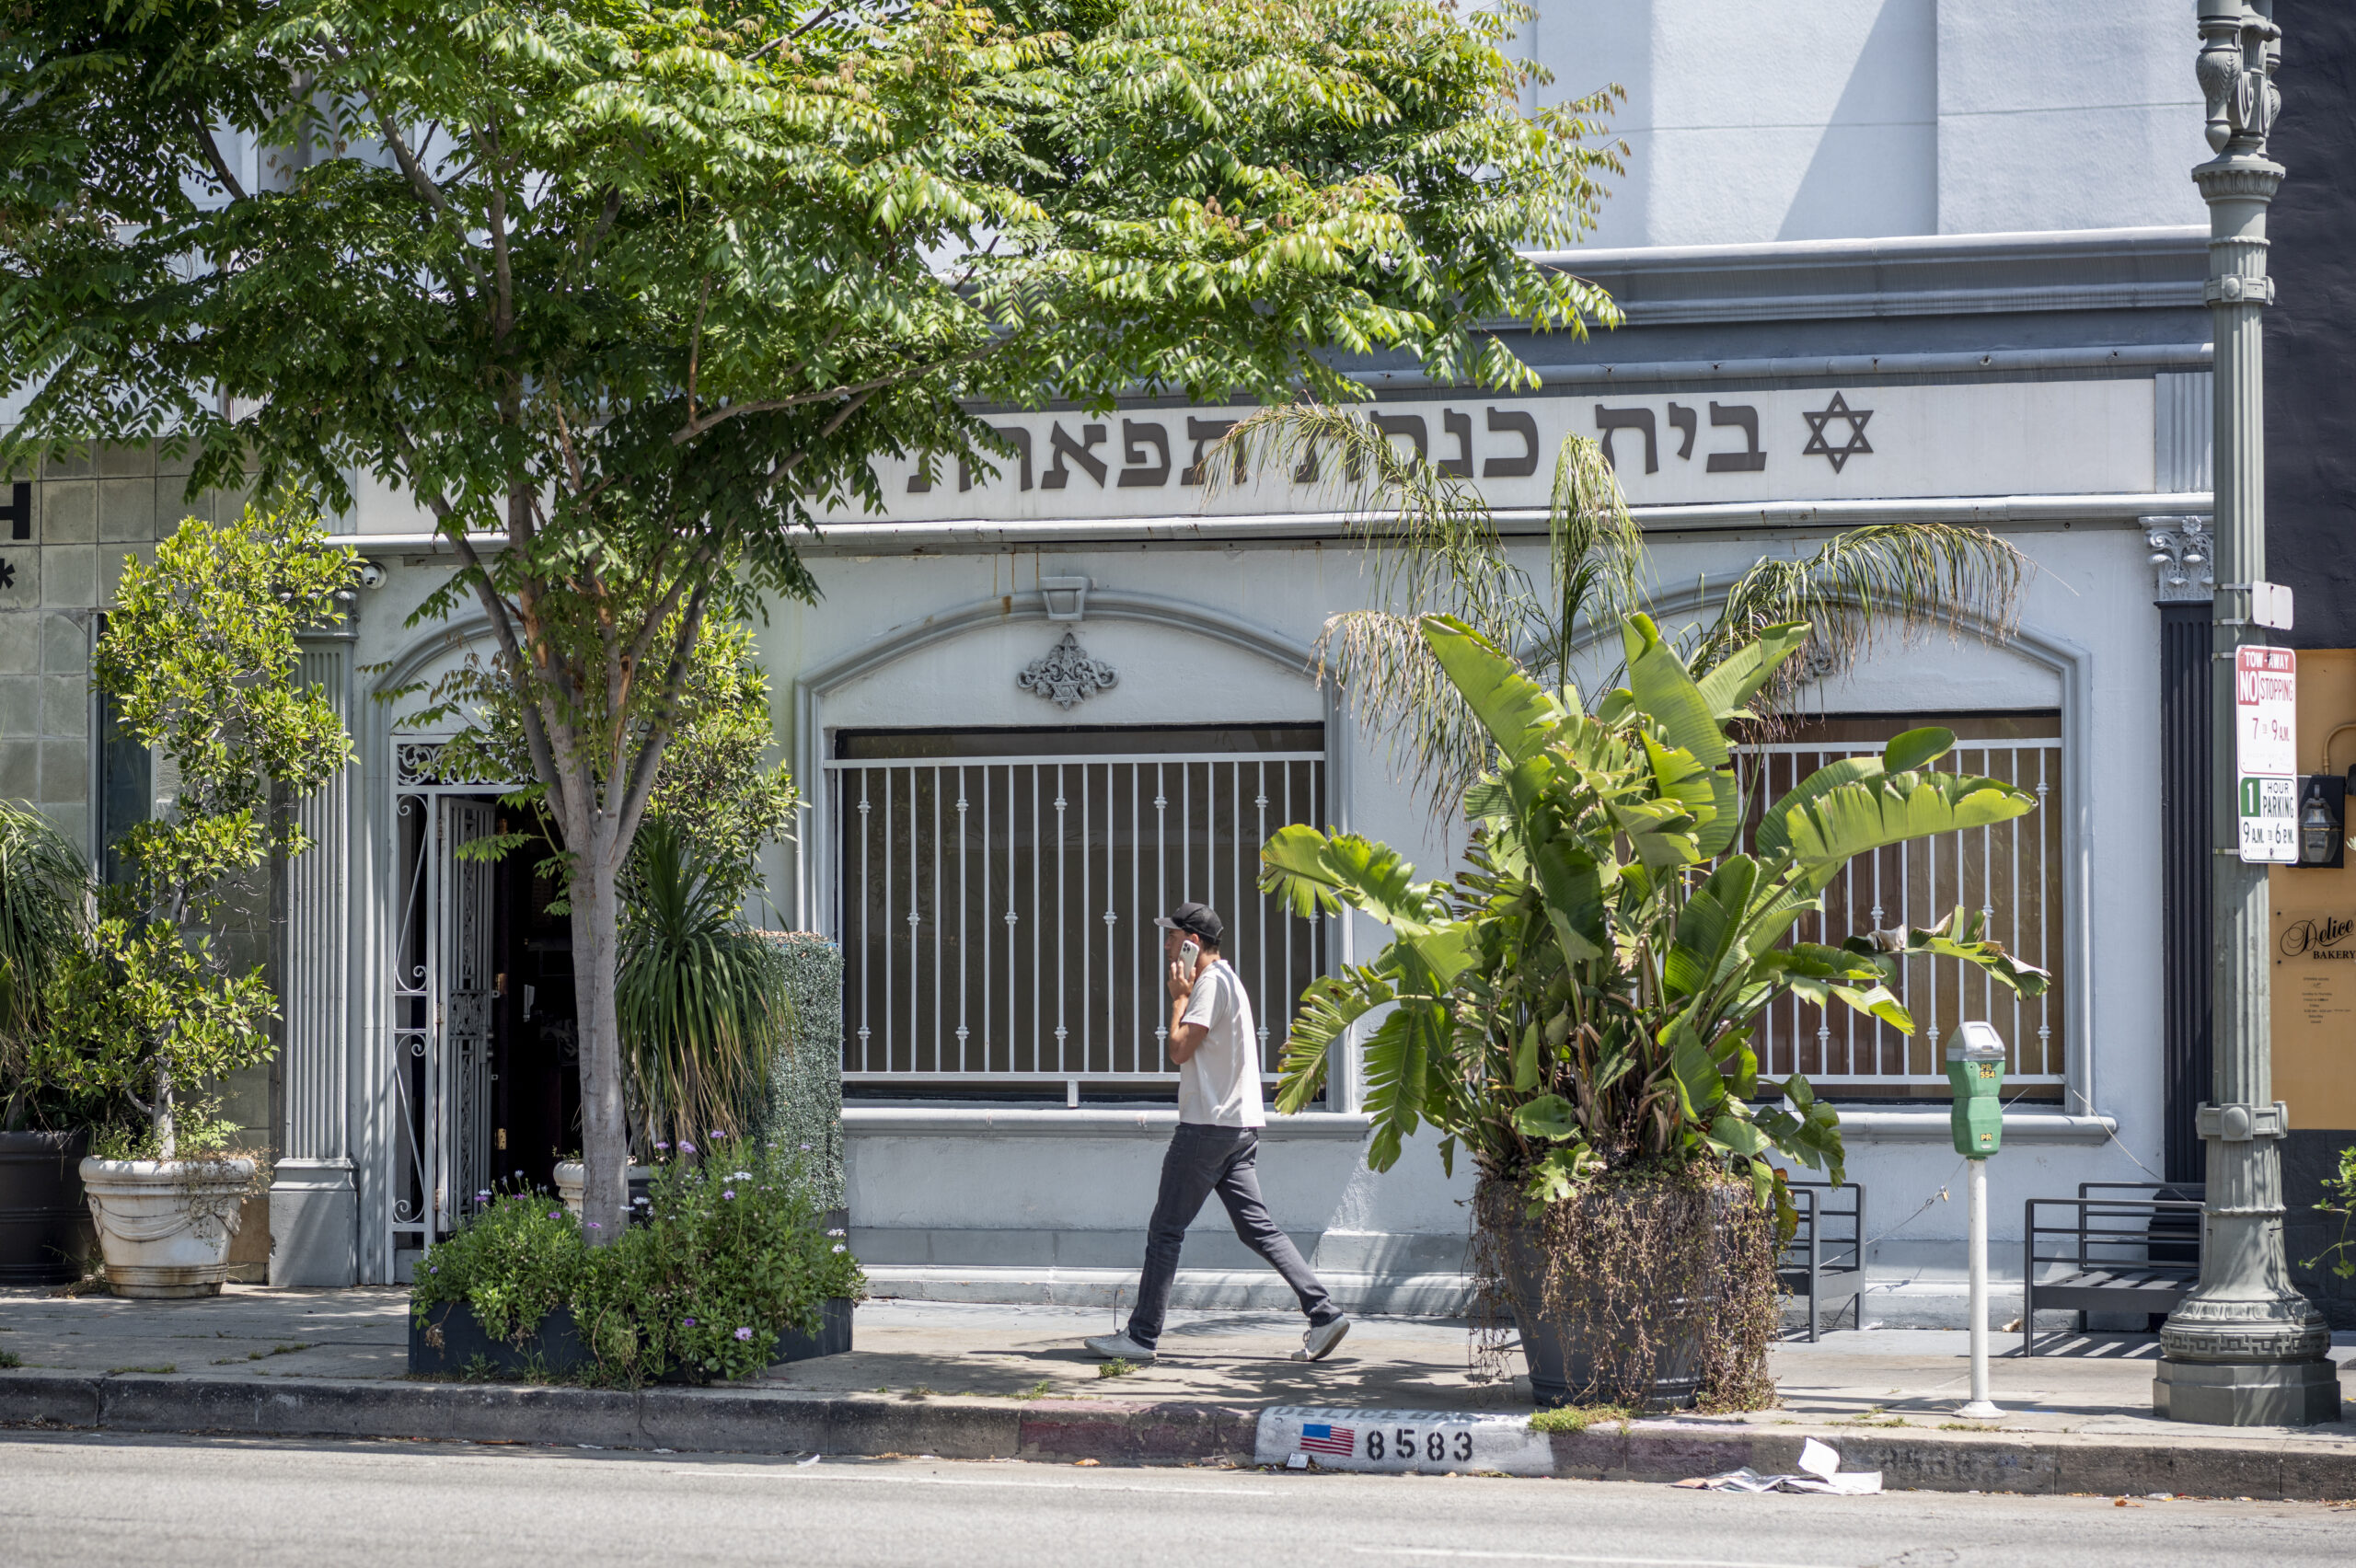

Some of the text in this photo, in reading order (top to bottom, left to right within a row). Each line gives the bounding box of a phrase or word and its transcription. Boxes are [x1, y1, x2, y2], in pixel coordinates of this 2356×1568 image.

[1595, 401, 1767, 475] בית
[2239, 670, 2293, 703] NO STOPPING
[2252, 718, 2259, 740] 7
[2271, 719, 2278, 741] 9
[2247, 782, 2254, 813] 1
[2267, 782, 2290, 794] HOUR
[2263, 796, 2294, 819] PARKING
[2243, 822, 2250, 844] 9
[2275, 823, 2281, 844] 6
[2281, 917, 2354, 956] Delice
[2313, 950, 2356, 960] BAKERY
[1272, 1407, 1399, 1420] DELICE
[1367, 1428, 1473, 1462] 8583
